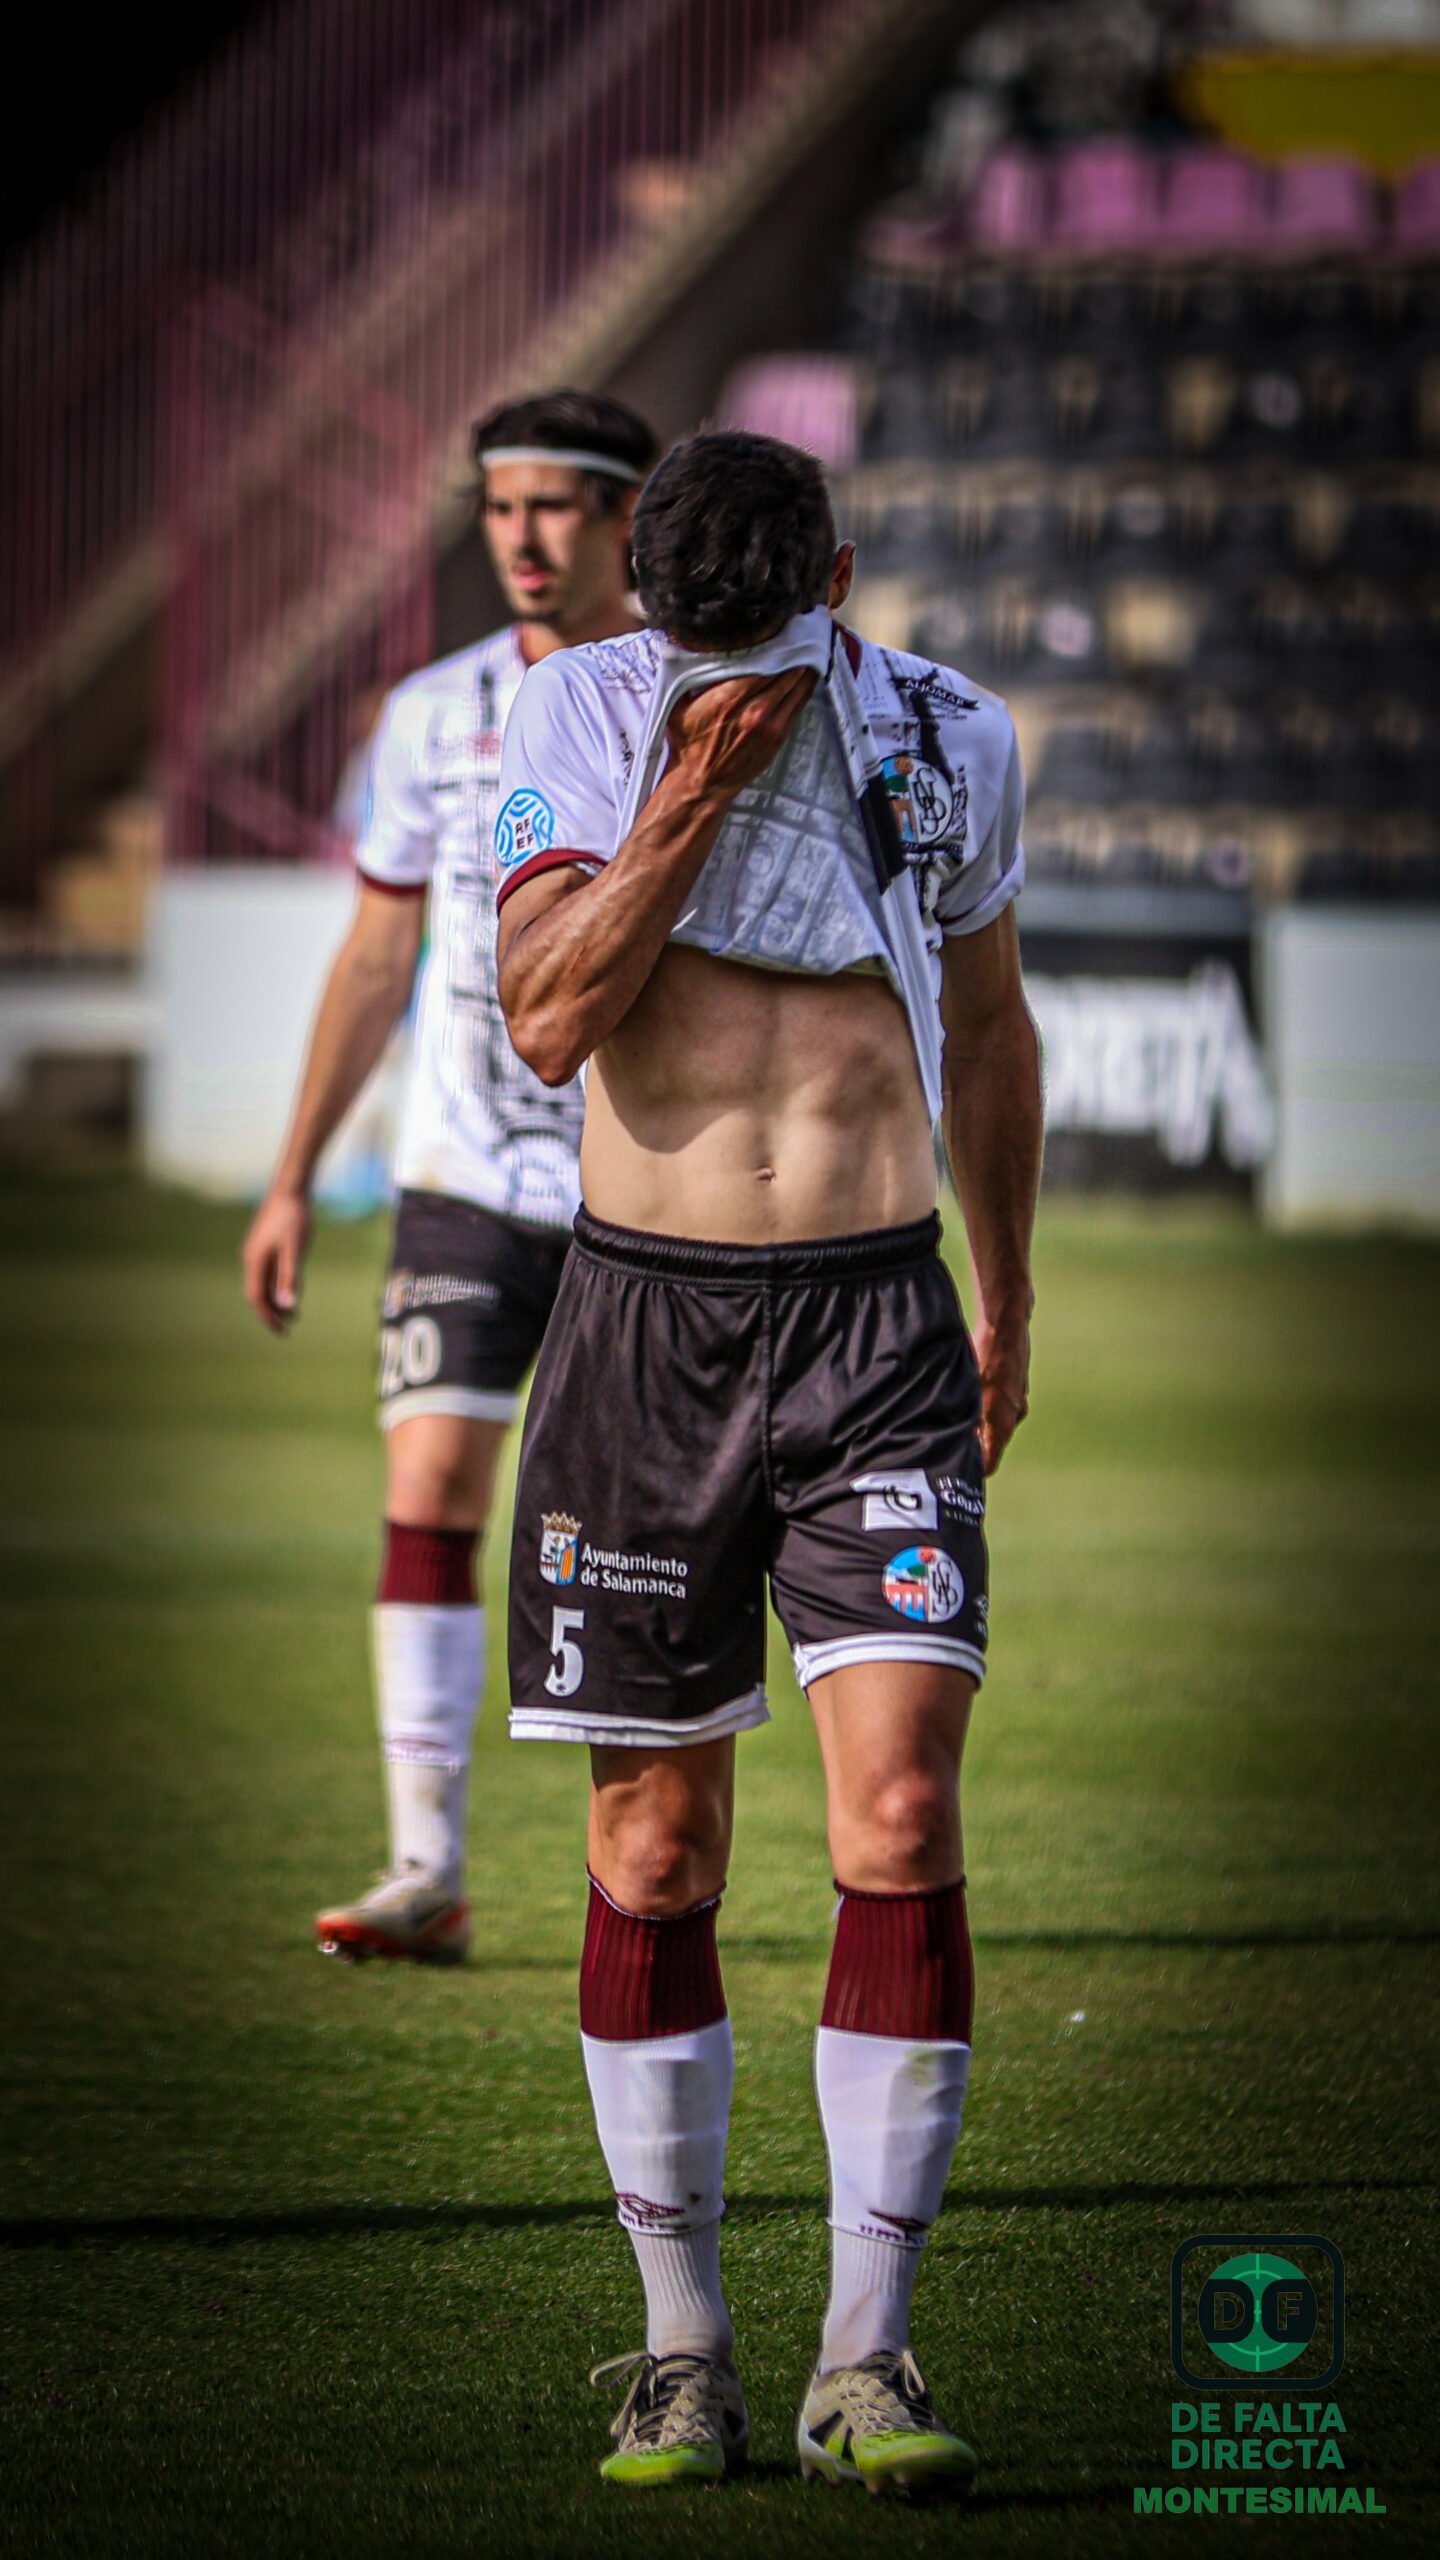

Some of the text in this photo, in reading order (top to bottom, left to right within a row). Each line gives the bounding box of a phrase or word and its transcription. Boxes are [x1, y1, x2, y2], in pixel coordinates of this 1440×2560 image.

[515, 818, 530, 834] RF
[516, 833, 534, 849] EF
[581, 1543, 688, 1577] Ayuntamiento
[581, 1565, 686, 1599] de Salamanca
[544, 1605, 585, 1696] 5
